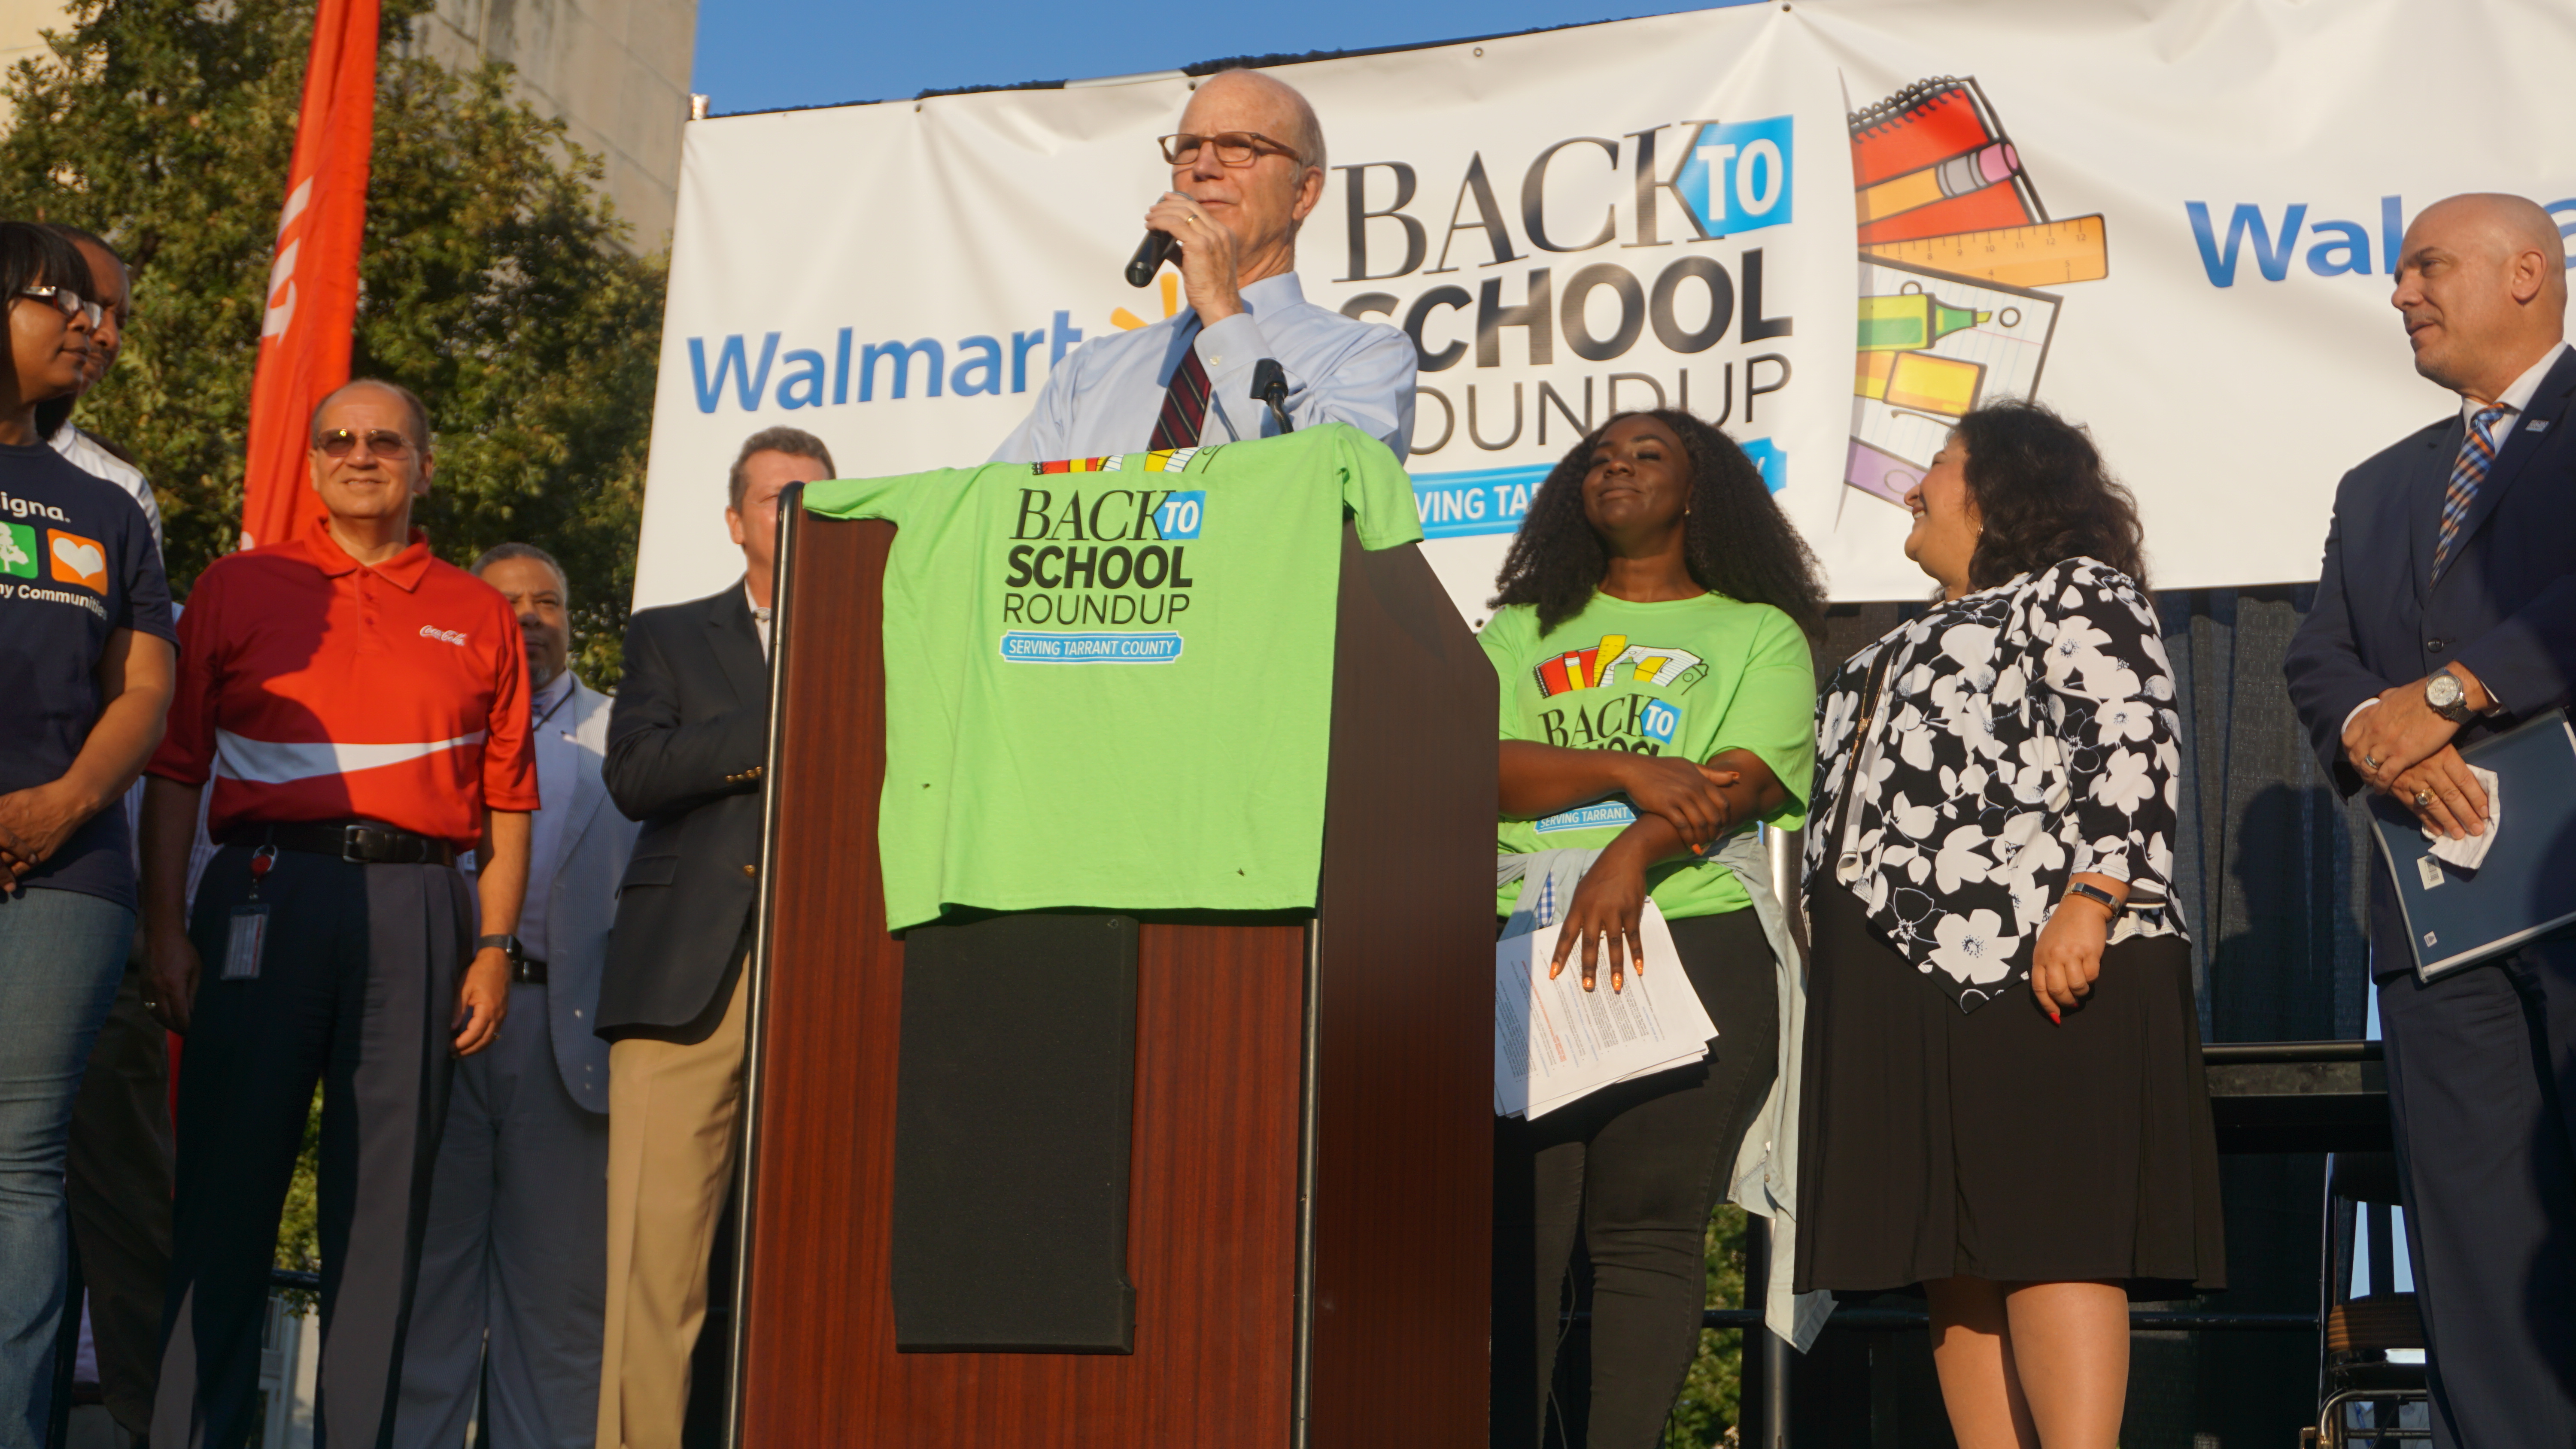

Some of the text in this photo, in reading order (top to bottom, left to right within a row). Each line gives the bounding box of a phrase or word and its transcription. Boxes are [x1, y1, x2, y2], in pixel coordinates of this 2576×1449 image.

[1697, 138, 1783, 221] TO
[1331, 119, 1725, 283] BACK
[1410, 353, 1792, 455] OUNDUP
[1009, 488, 1176, 542] BACK
[1163, 500, 1199, 533] TO
[1413, 488, 1485, 523] VING
[1005, 544, 1193, 589] SCHOOL
[18, 584, 108, 621] Communities
[1003, 593, 1190, 624] ROUNDUP
[1009, 639, 1175, 656] SERVING TARRANT COUNTY
[1538, 693, 1659, 747] BACK
[1645, 705, 1674, 736] TO
[1540, 811, 1580, 828] SERVING
[1582, 806, 1629, 822] TARRANT
